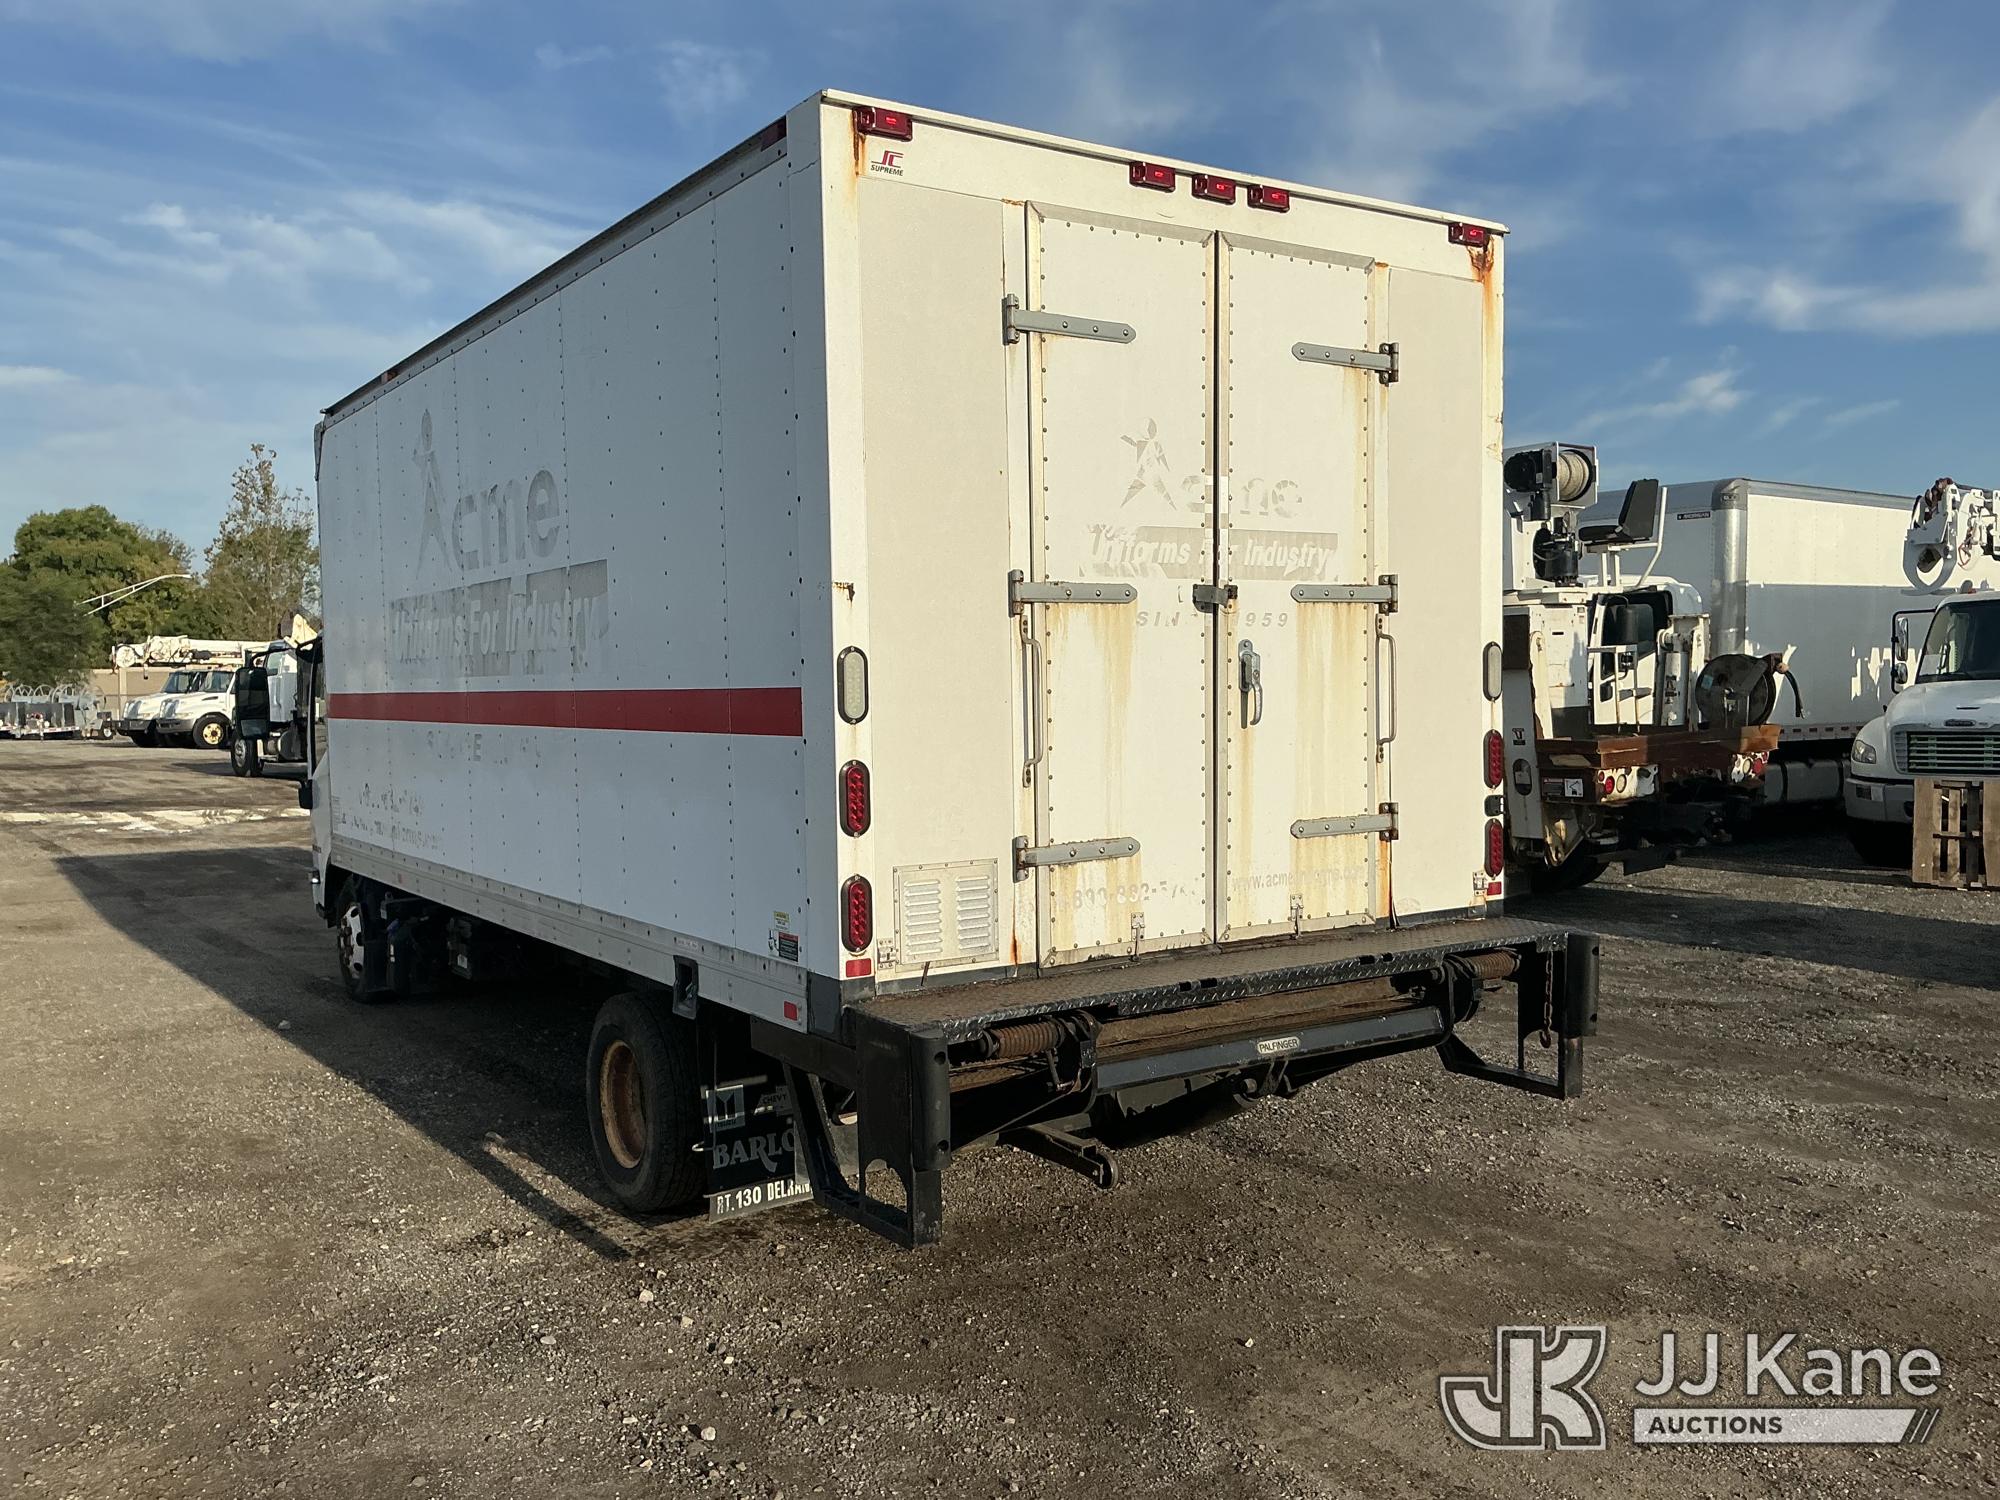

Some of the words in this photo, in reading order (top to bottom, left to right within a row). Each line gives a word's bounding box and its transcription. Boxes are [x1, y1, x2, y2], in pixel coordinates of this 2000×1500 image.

[871, 164, 904, 177] SUPREME
[1243, 538, 1331, 575] Industry
[469, 598, 500, 655] For
[1259, 1038, 1298, 1053] PALFINGER
[735, 1186, 762, 1209] 130
